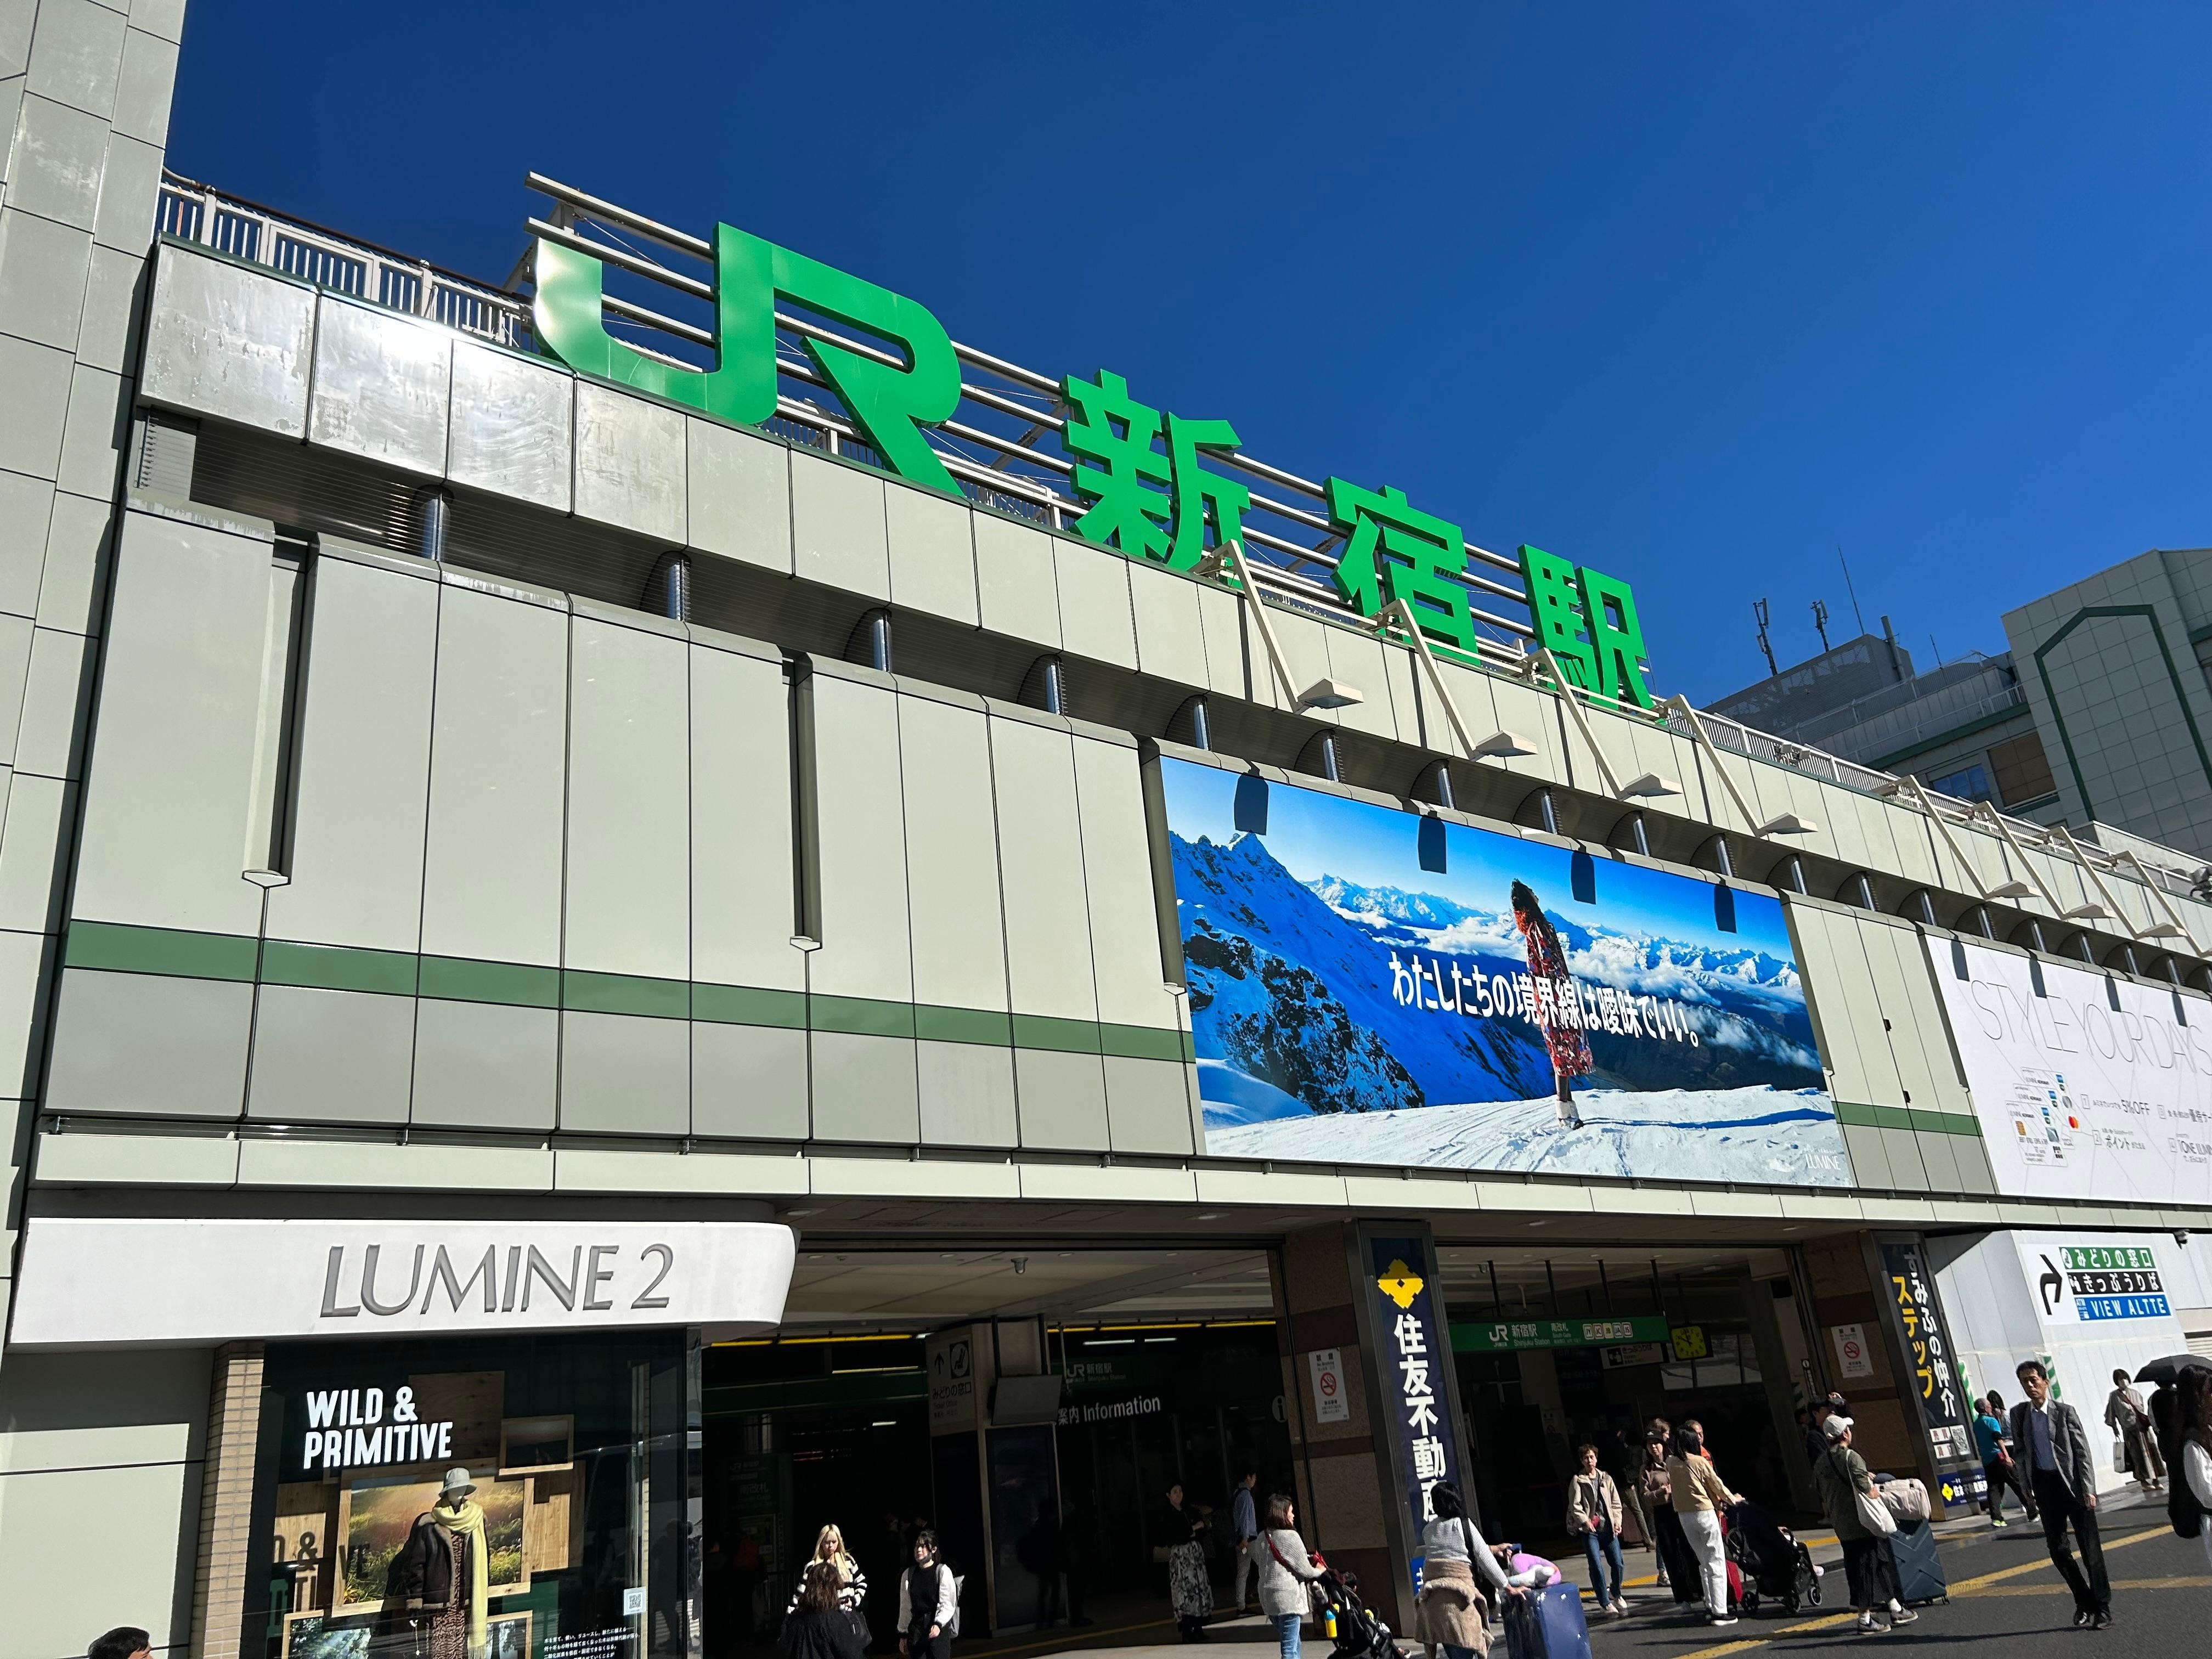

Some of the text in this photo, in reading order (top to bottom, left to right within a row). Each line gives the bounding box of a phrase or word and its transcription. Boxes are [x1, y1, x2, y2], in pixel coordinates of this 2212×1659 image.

[533, 222, 1657, 711] JR 新宿駅
[1389, 951, 1699, 1048] わたしたちの境界線は曖昧でいい。
[1971, 980, 2078, 1053] STYLE
[2066, 998, 2154, 1066] YOUR
[2074, 1248, 2152, 1268] みどりの窓口
[320, 1243, 674, 1318] LUMINE 2
[2083, 1272, 2159, 1293] きっぷうりば
[2090, 1299, 2122, 1317] VIEW
[2128, 1297, 2166, 1315] ALTTE
[1488, 1323, 1537, 1342] JR 新宿駅
[1893, 1276, 1933, 1399] ステップ
[1904, 1251, 1956, 1418] すみふの仲介
[932, 1381, 972, 1400] みどりの窓口
[1067, 1364, 1085, 1377] JR
[307, 1386, 418, 1428] WILD &
[1084, 1395, 1161, 1423] Information
[303, 1421, 453, 1469] PRIMITIVE
